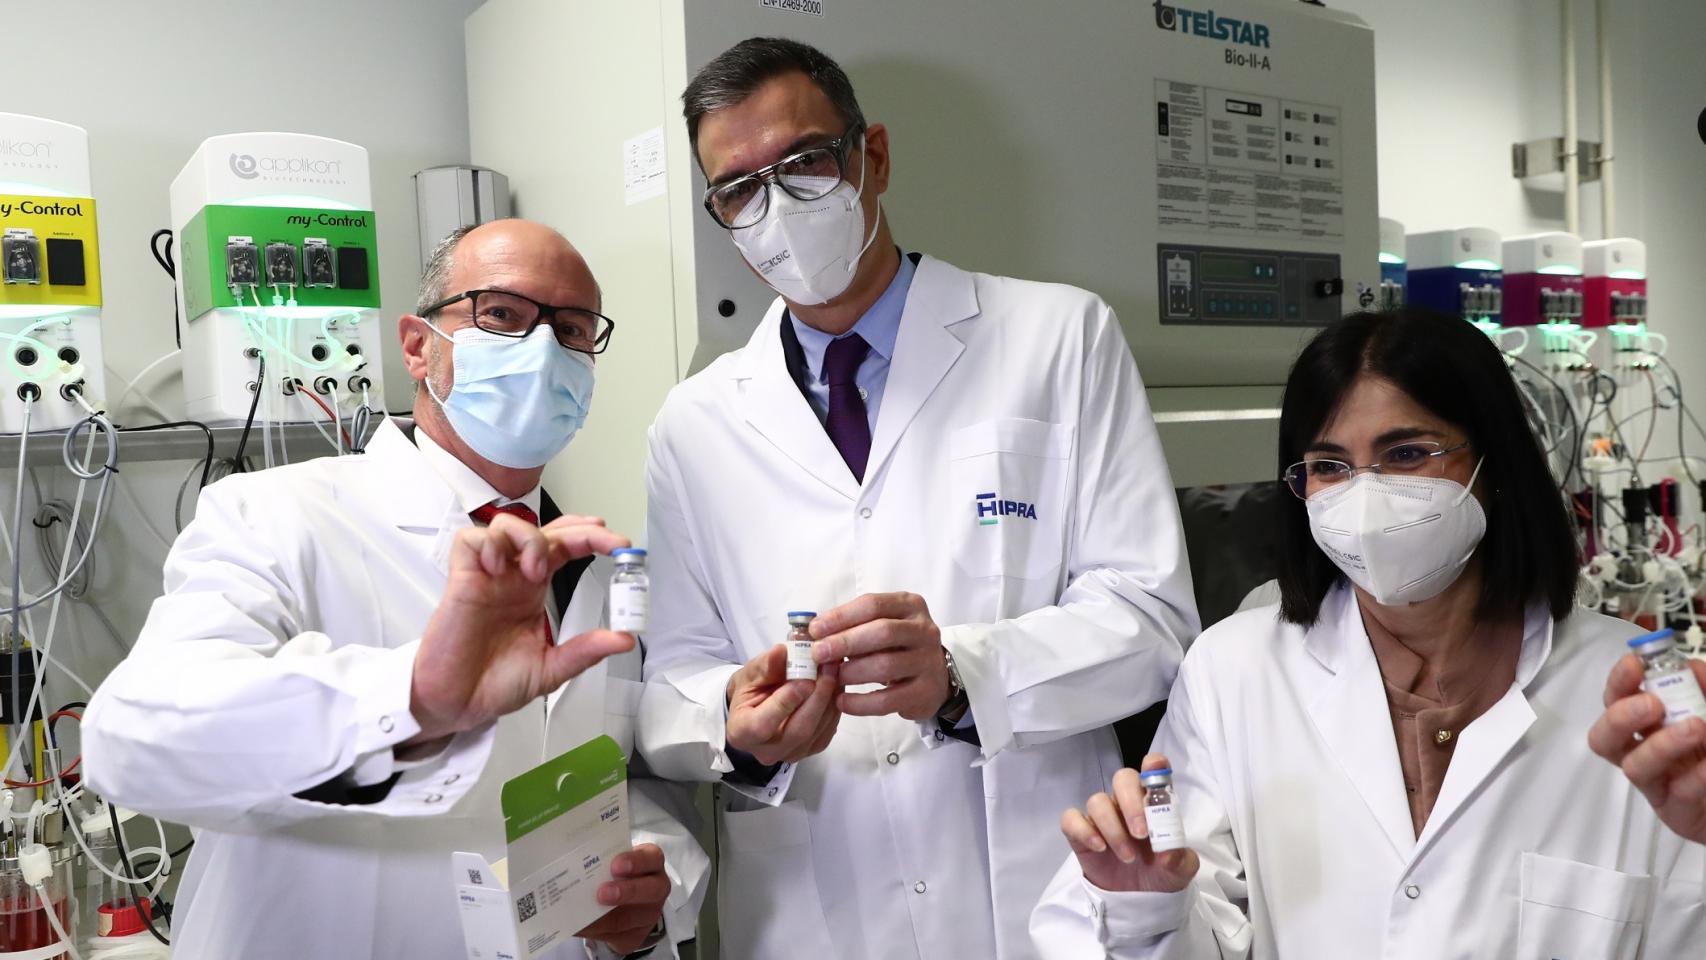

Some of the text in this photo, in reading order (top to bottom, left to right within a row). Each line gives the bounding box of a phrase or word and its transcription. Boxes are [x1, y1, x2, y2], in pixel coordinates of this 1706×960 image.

[259, 155, 341, 176] applikon
[286, 213, 367, 228] my-Control
[976, 499, 1038, 521] HIPRA
[600, 805, 620, 821] HIPRA
[583, 855, 601, 870] HIPRA
